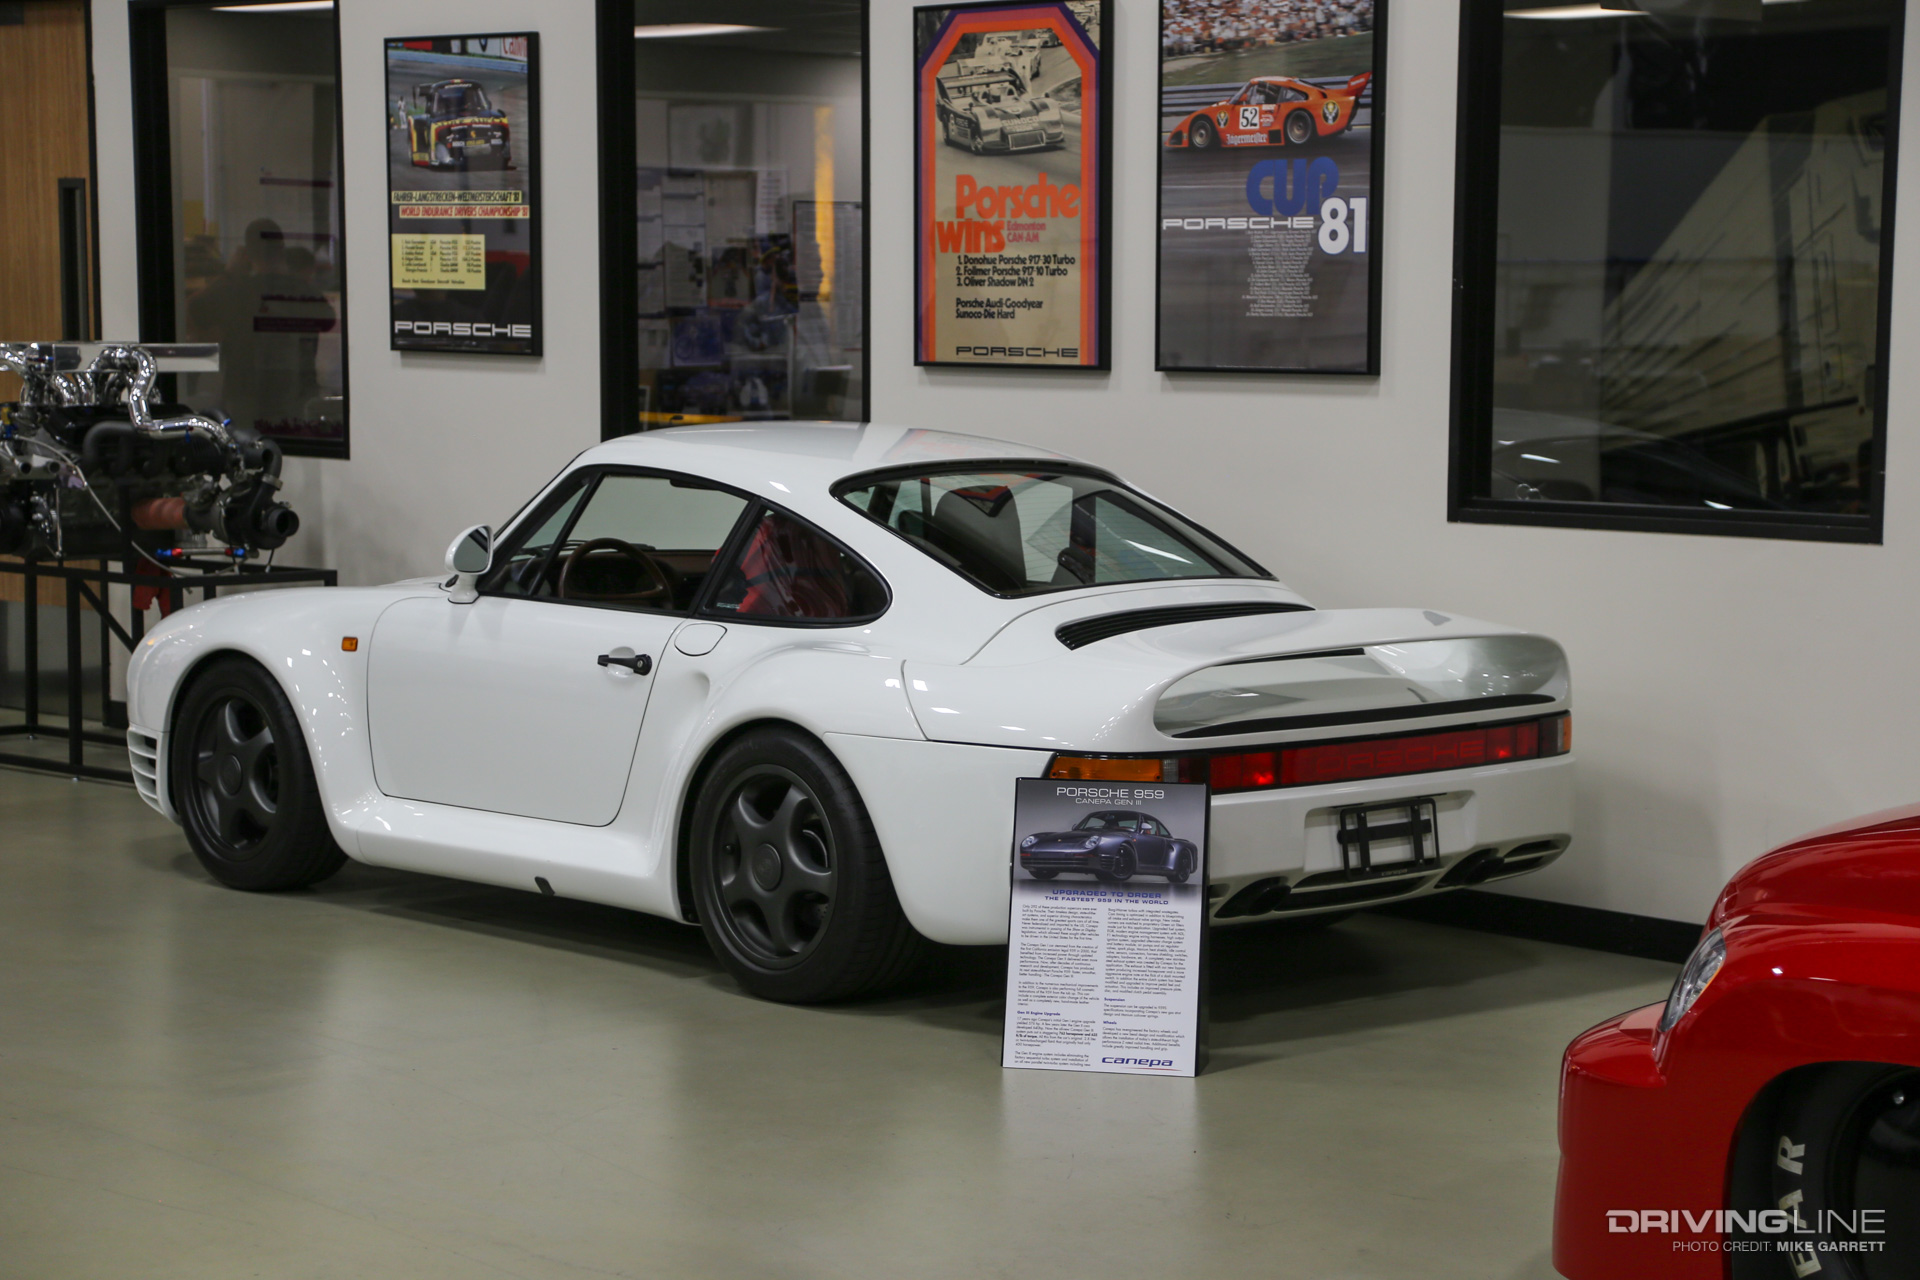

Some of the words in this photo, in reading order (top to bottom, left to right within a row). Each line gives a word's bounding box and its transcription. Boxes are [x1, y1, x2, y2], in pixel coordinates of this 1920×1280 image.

[1001, 115, 1039, 127] SUNOCO
[1241, 107, 1258, 128] 52
[1246, 156, 1340, 217] CUP
[955, 172, 1081, 219] Porsche
[401, 206, 420, 217] WORLD
[421, 206, 454, 217] ENDURANCE
[454, 206, 477, 217] DRIVERS
[478, 206, 520, 217] CHAMPIONSHIP
[1006, 220, 1047, 231] Edmonton
[1162, 216, 1314, 230] PORSCHE
[1318, 197, 1368, 255] 81
[935, 218, 1006, 254] wins
[957, 254, 962, 265] 1.
[964, 254, 997, 265] Donohue
[998, 254, 1027, 265] Porsche
[1028, 254, 1052, 265] 917-30
[1052, 254, 1076, 265] Turbo
[956, 266, 962, 276] 2.
[964, 266, 991, 276] Follmer
[992, 266, 1020, 276] Porsche
[1022, 266, 1044, 276] 917-10
[1045, 266, 1068, 276] Turbo
[956, 277, 962, 287] 3.
[964, 277, 986, 287] Oliver
[988, 277, 1016, 287] Shadow
[1018, 277, 1028, 287] DN
[1029, 277, 1034, 287] 2
[956, 297, 984, 308] Porsche
[997, 308, 1015, 319] Hard
[394, 320, 532, 338] PORSCHE
[956, 346, 1078, 358] PORSCHE
[1308, 739, 1485, 775] ORSCHE
[1056, 786, 1129, 799] PORSCHE
[1134, 789, 1165, 800] 959
[1075, 797, 1112, 805] CANEPA
[1114, 798, 1133, 806] GEN
[1052, 888, 1107, 897] UPGRADED
[1101, 1056, 1174, 1068] canepa
